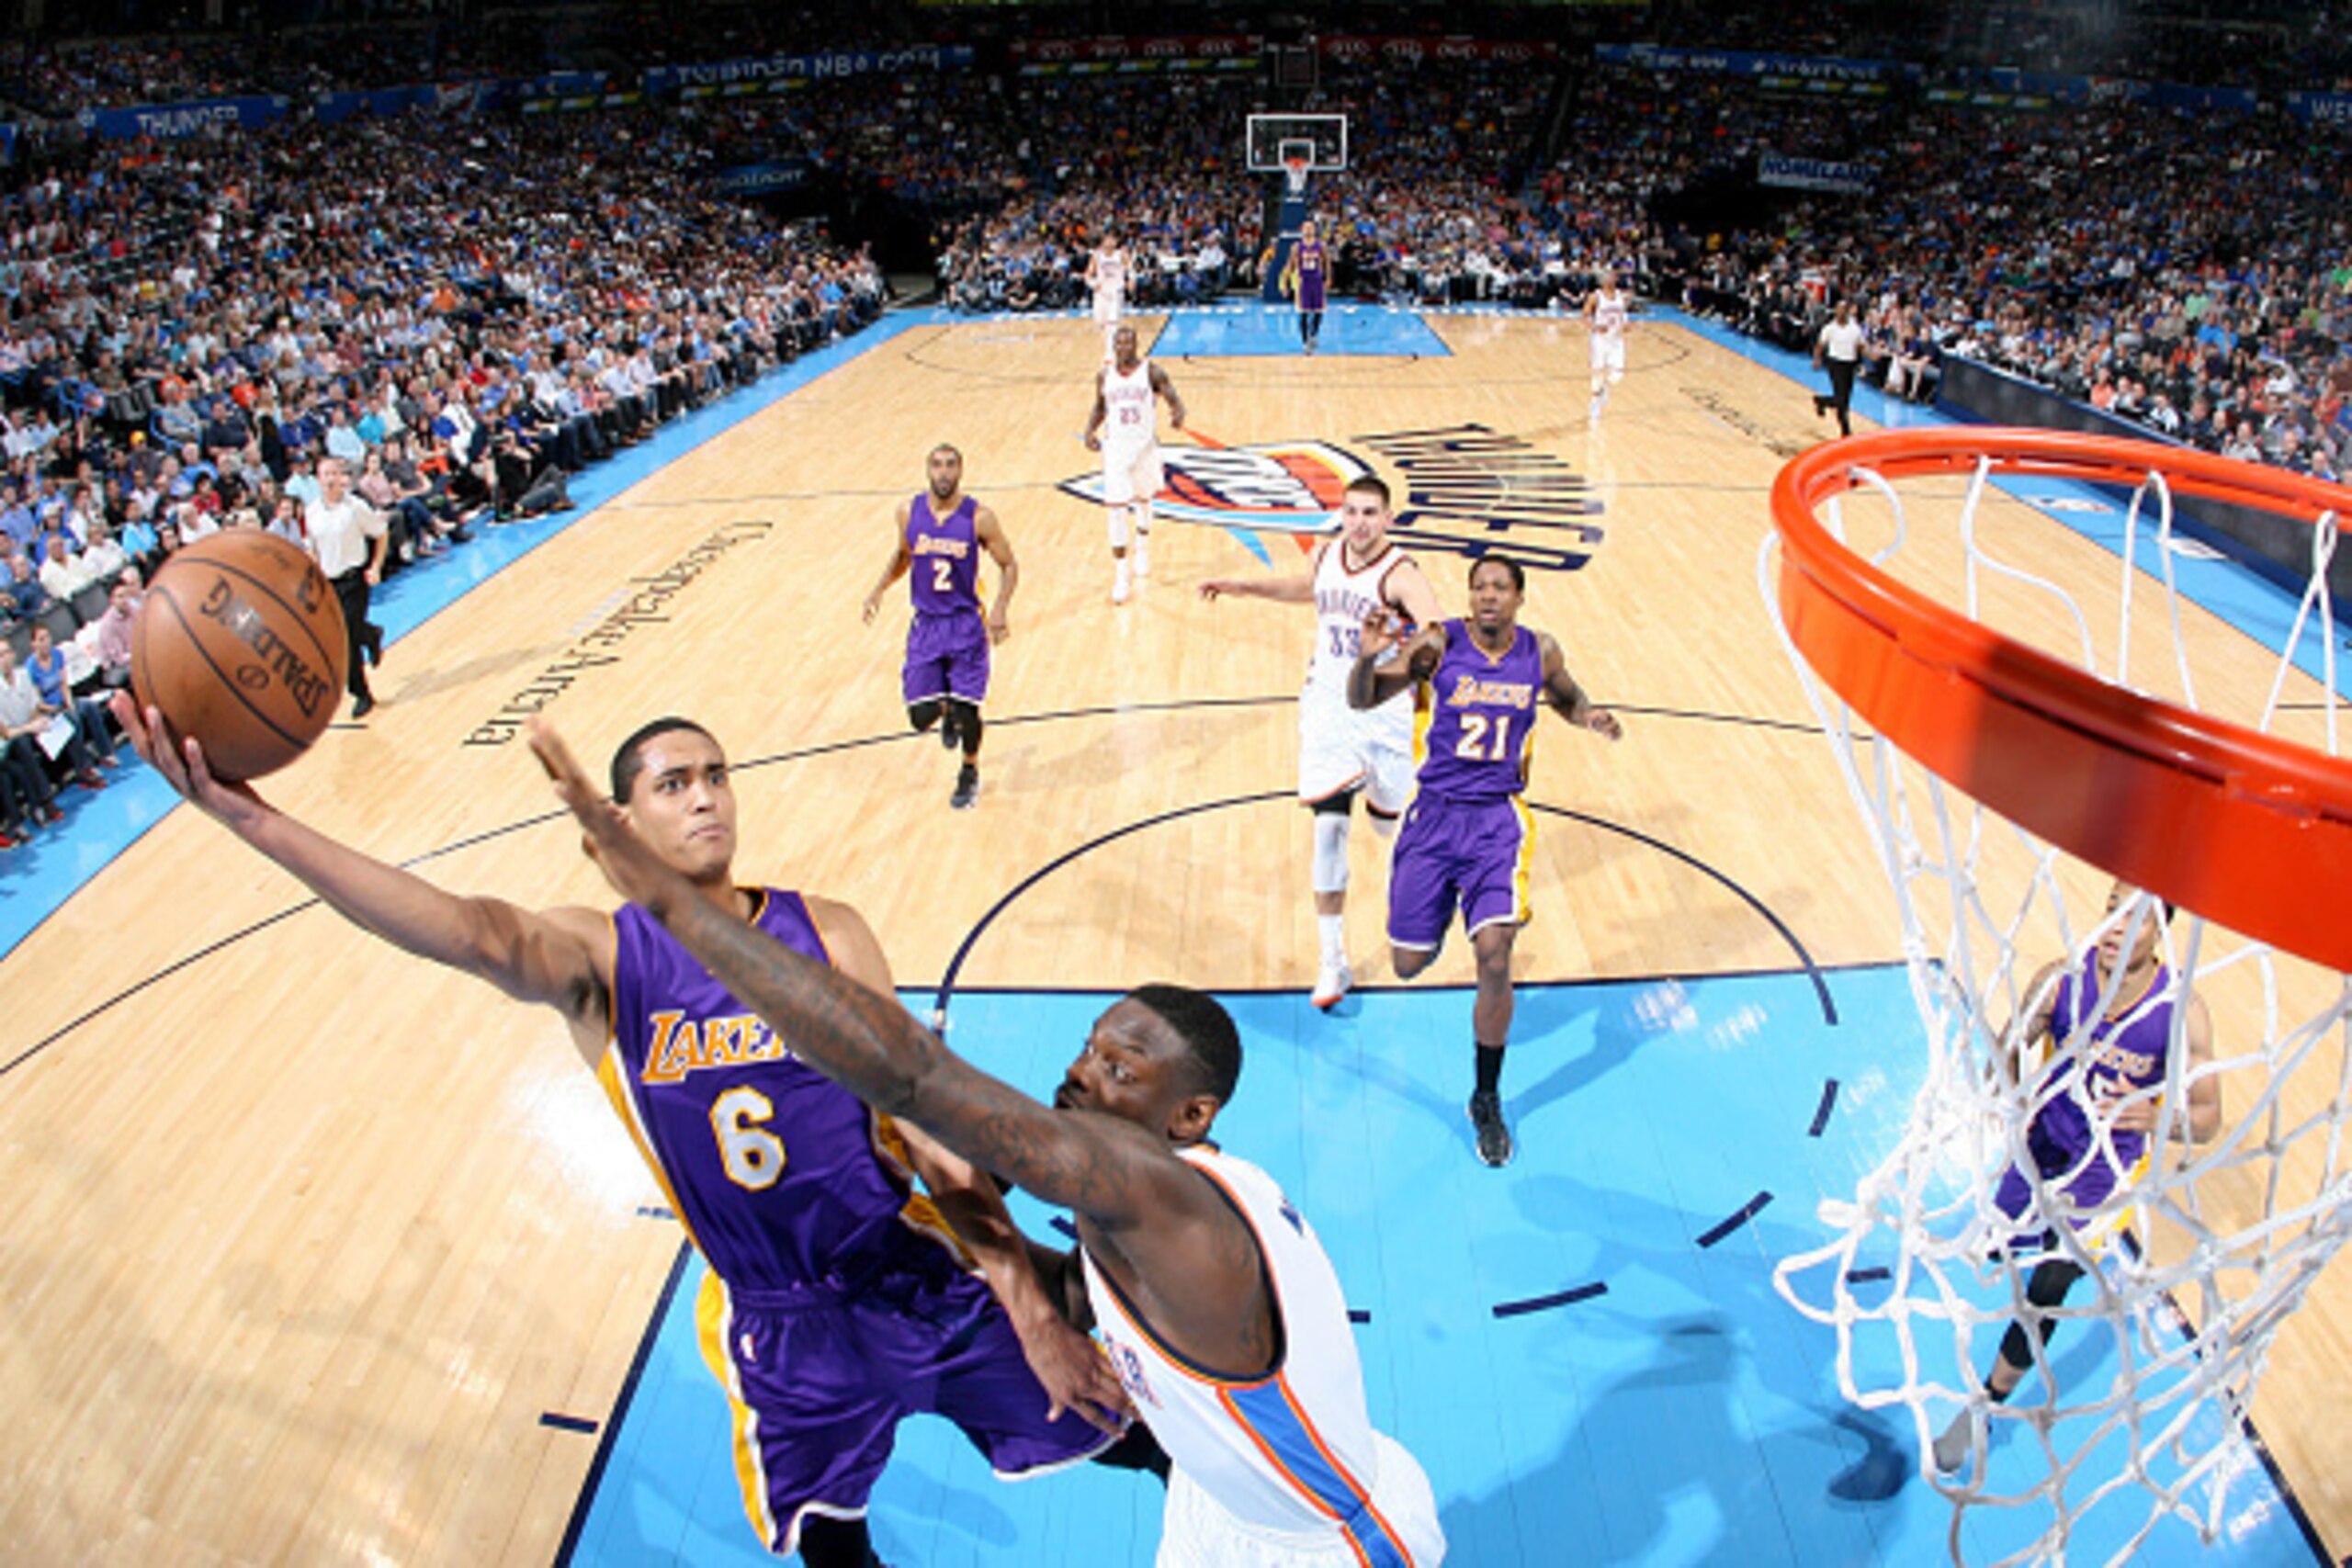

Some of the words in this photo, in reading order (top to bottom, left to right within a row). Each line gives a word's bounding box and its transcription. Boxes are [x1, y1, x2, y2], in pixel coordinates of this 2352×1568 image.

[932, 558, 954, 592] 2
[1453, 711, 1510, 761] 21
[640, 1009, 794, 1086] LAKE
[707, 1083, 788, 1192] 6
